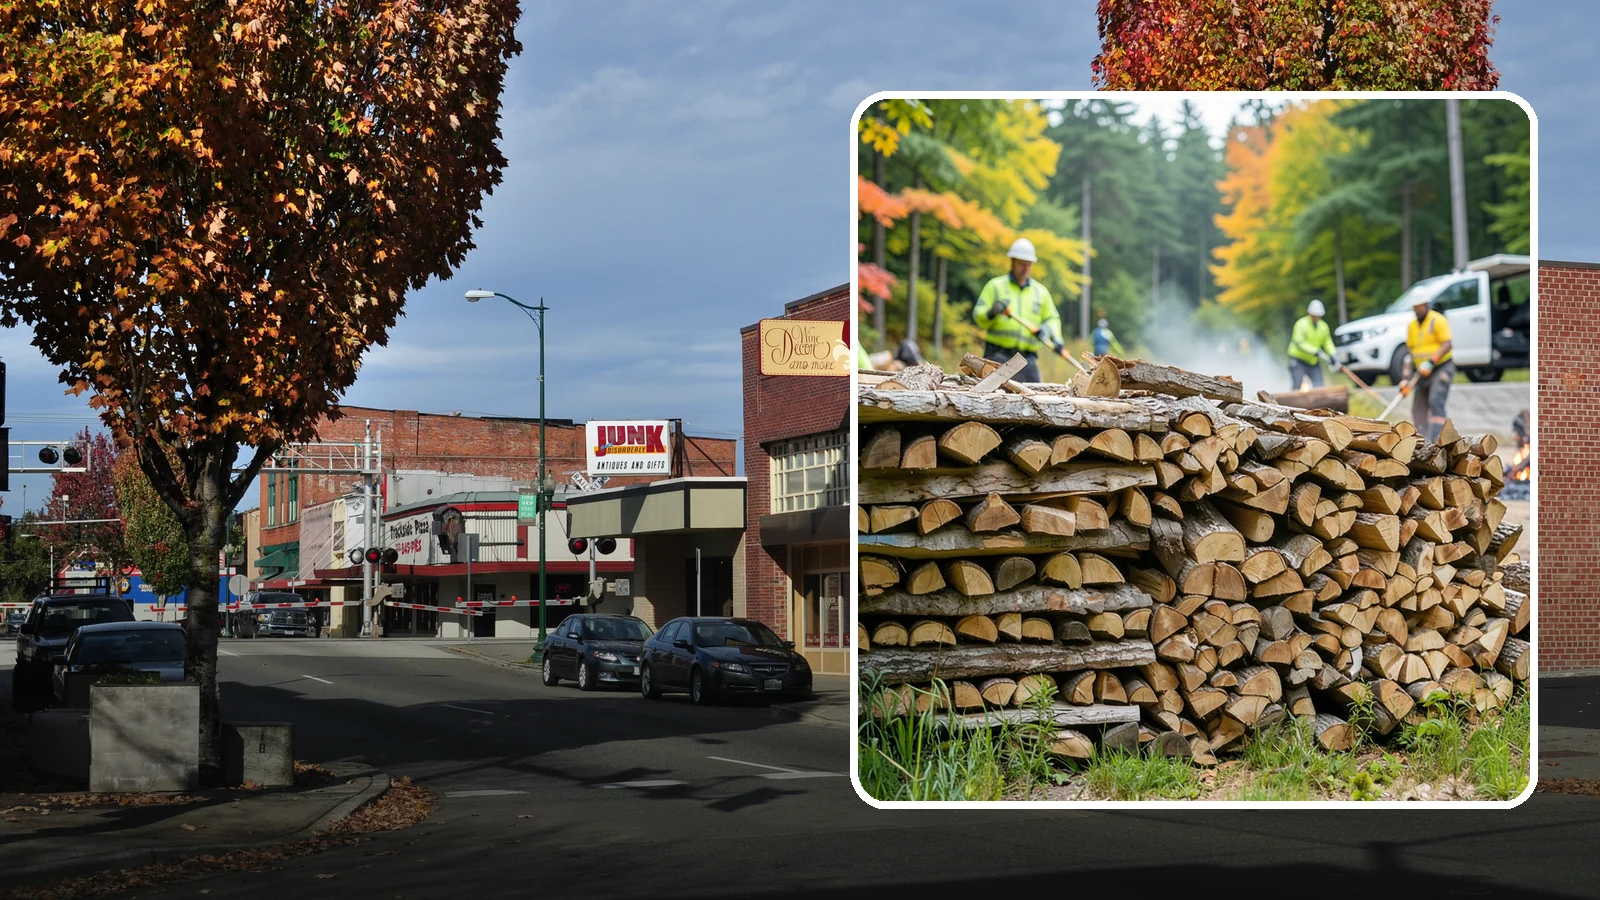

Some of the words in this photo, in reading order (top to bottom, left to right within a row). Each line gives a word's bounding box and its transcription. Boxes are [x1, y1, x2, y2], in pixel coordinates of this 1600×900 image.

[595, 425, 664, 457] JUNK
[607, 446, 646, 454] DISORDERLY
[597, 461, 628, 470] ANTIQUES
[631, 461, 644, 470] AND
[647, 460, 665, 469] GIFTS
[390, 522, 413, 540] Trackside
[415, 519, 429, 534] Pizza
